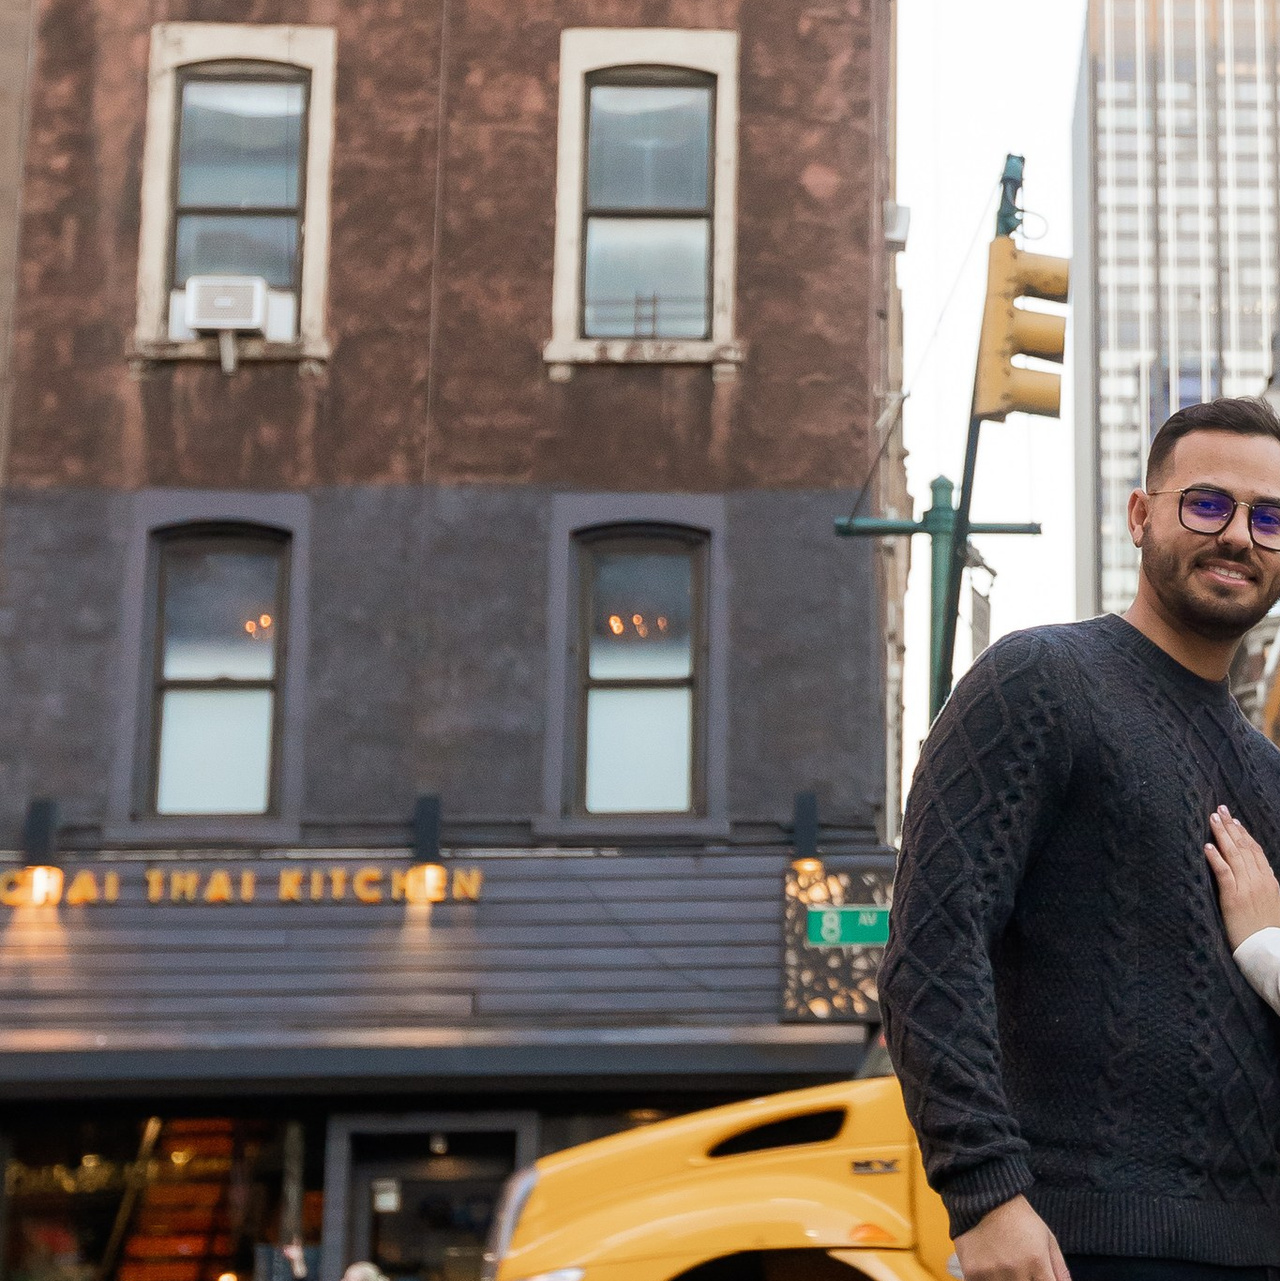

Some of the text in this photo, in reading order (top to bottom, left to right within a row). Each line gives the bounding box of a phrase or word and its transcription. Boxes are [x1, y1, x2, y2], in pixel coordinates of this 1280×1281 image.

[146, 868, 255, 903] THAI
[279, 865, 482, 903] KITCHEN
[821, 910, 841, 943] 8
